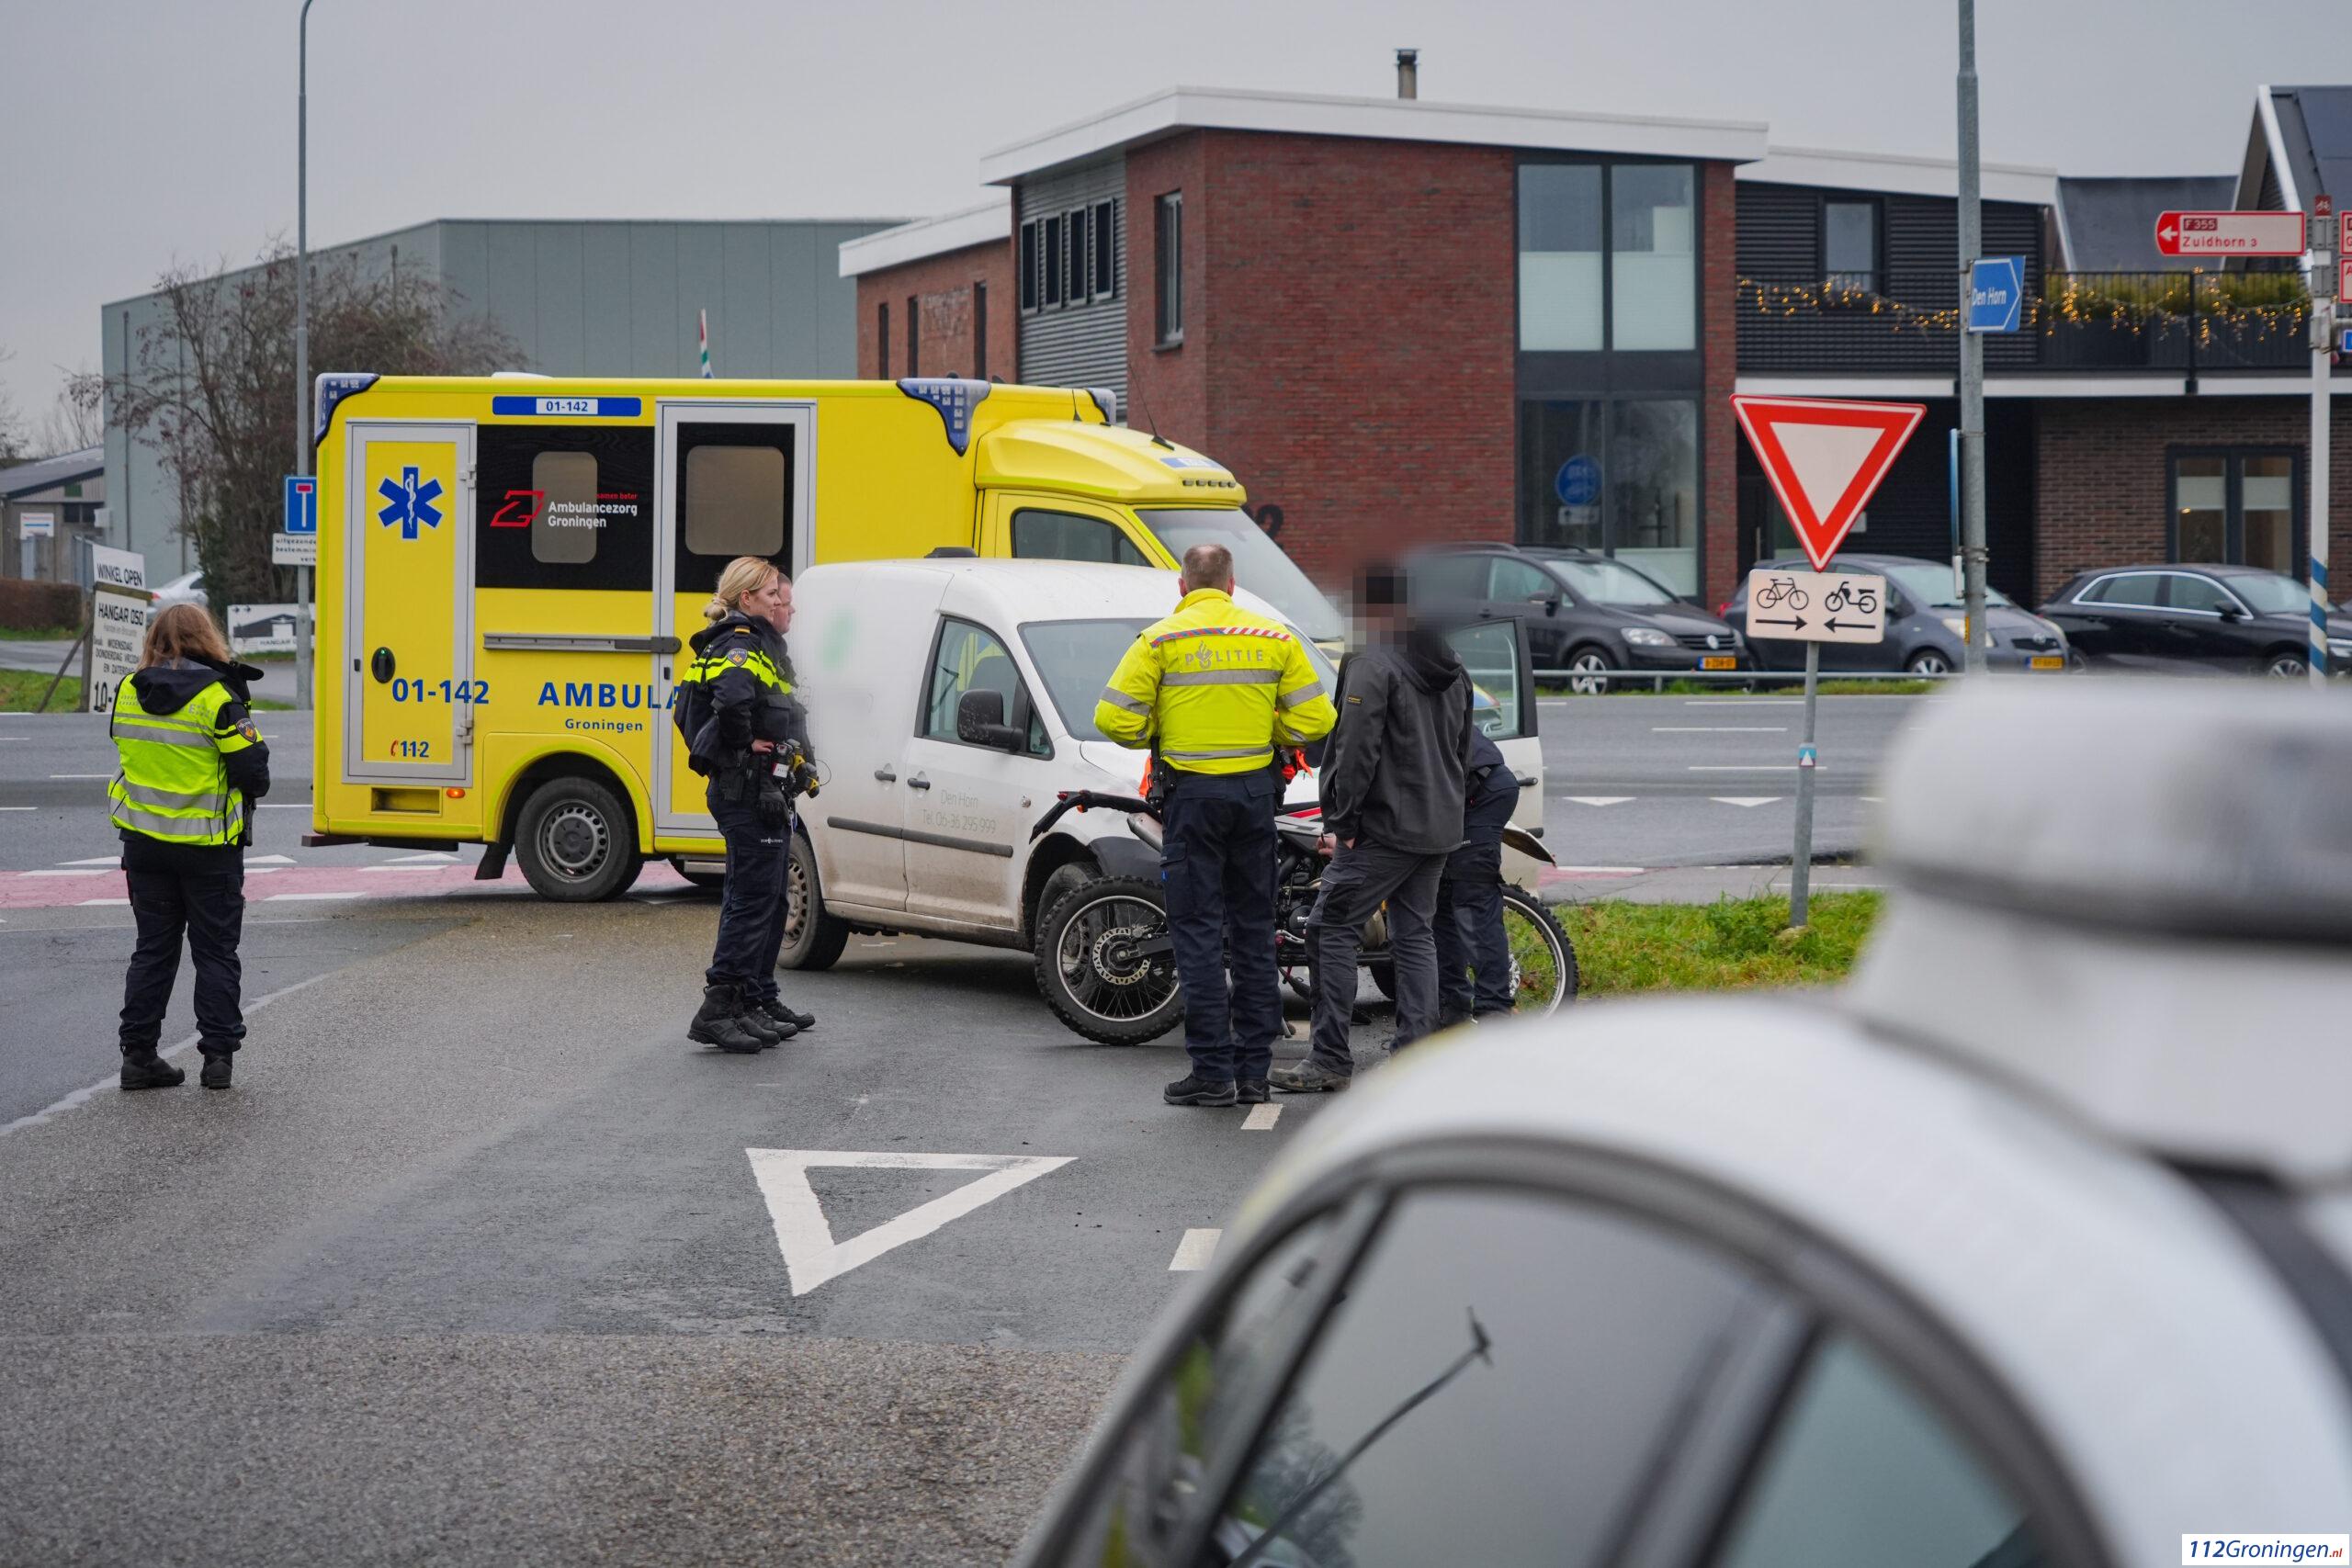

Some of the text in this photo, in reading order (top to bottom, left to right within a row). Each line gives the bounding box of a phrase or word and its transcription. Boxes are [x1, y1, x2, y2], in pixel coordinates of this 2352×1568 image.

[2196, 220, 2216, 229] 355
[2182, 236, 2257, 247] Zuidhorn 3
[1972, 287, 2007, 306] Den Horn
[546, 400, 588, 412] 01-142
[548, 502, 638, 516] Ambulancezorg
[548, 515, 606, 529] Groningen
[96, 563, 142, 586] WINKEL OPEN
[98, 603, 129, 623] HANGAR
[95, 648, 123, 661] DONDERDAG
[392, 678, 489, 704] 01-142
[537, 682, 682, 709] AMBULA
[565, 718, 643, 733] Groningen
[941, 789, 978, 808] Den Horn
